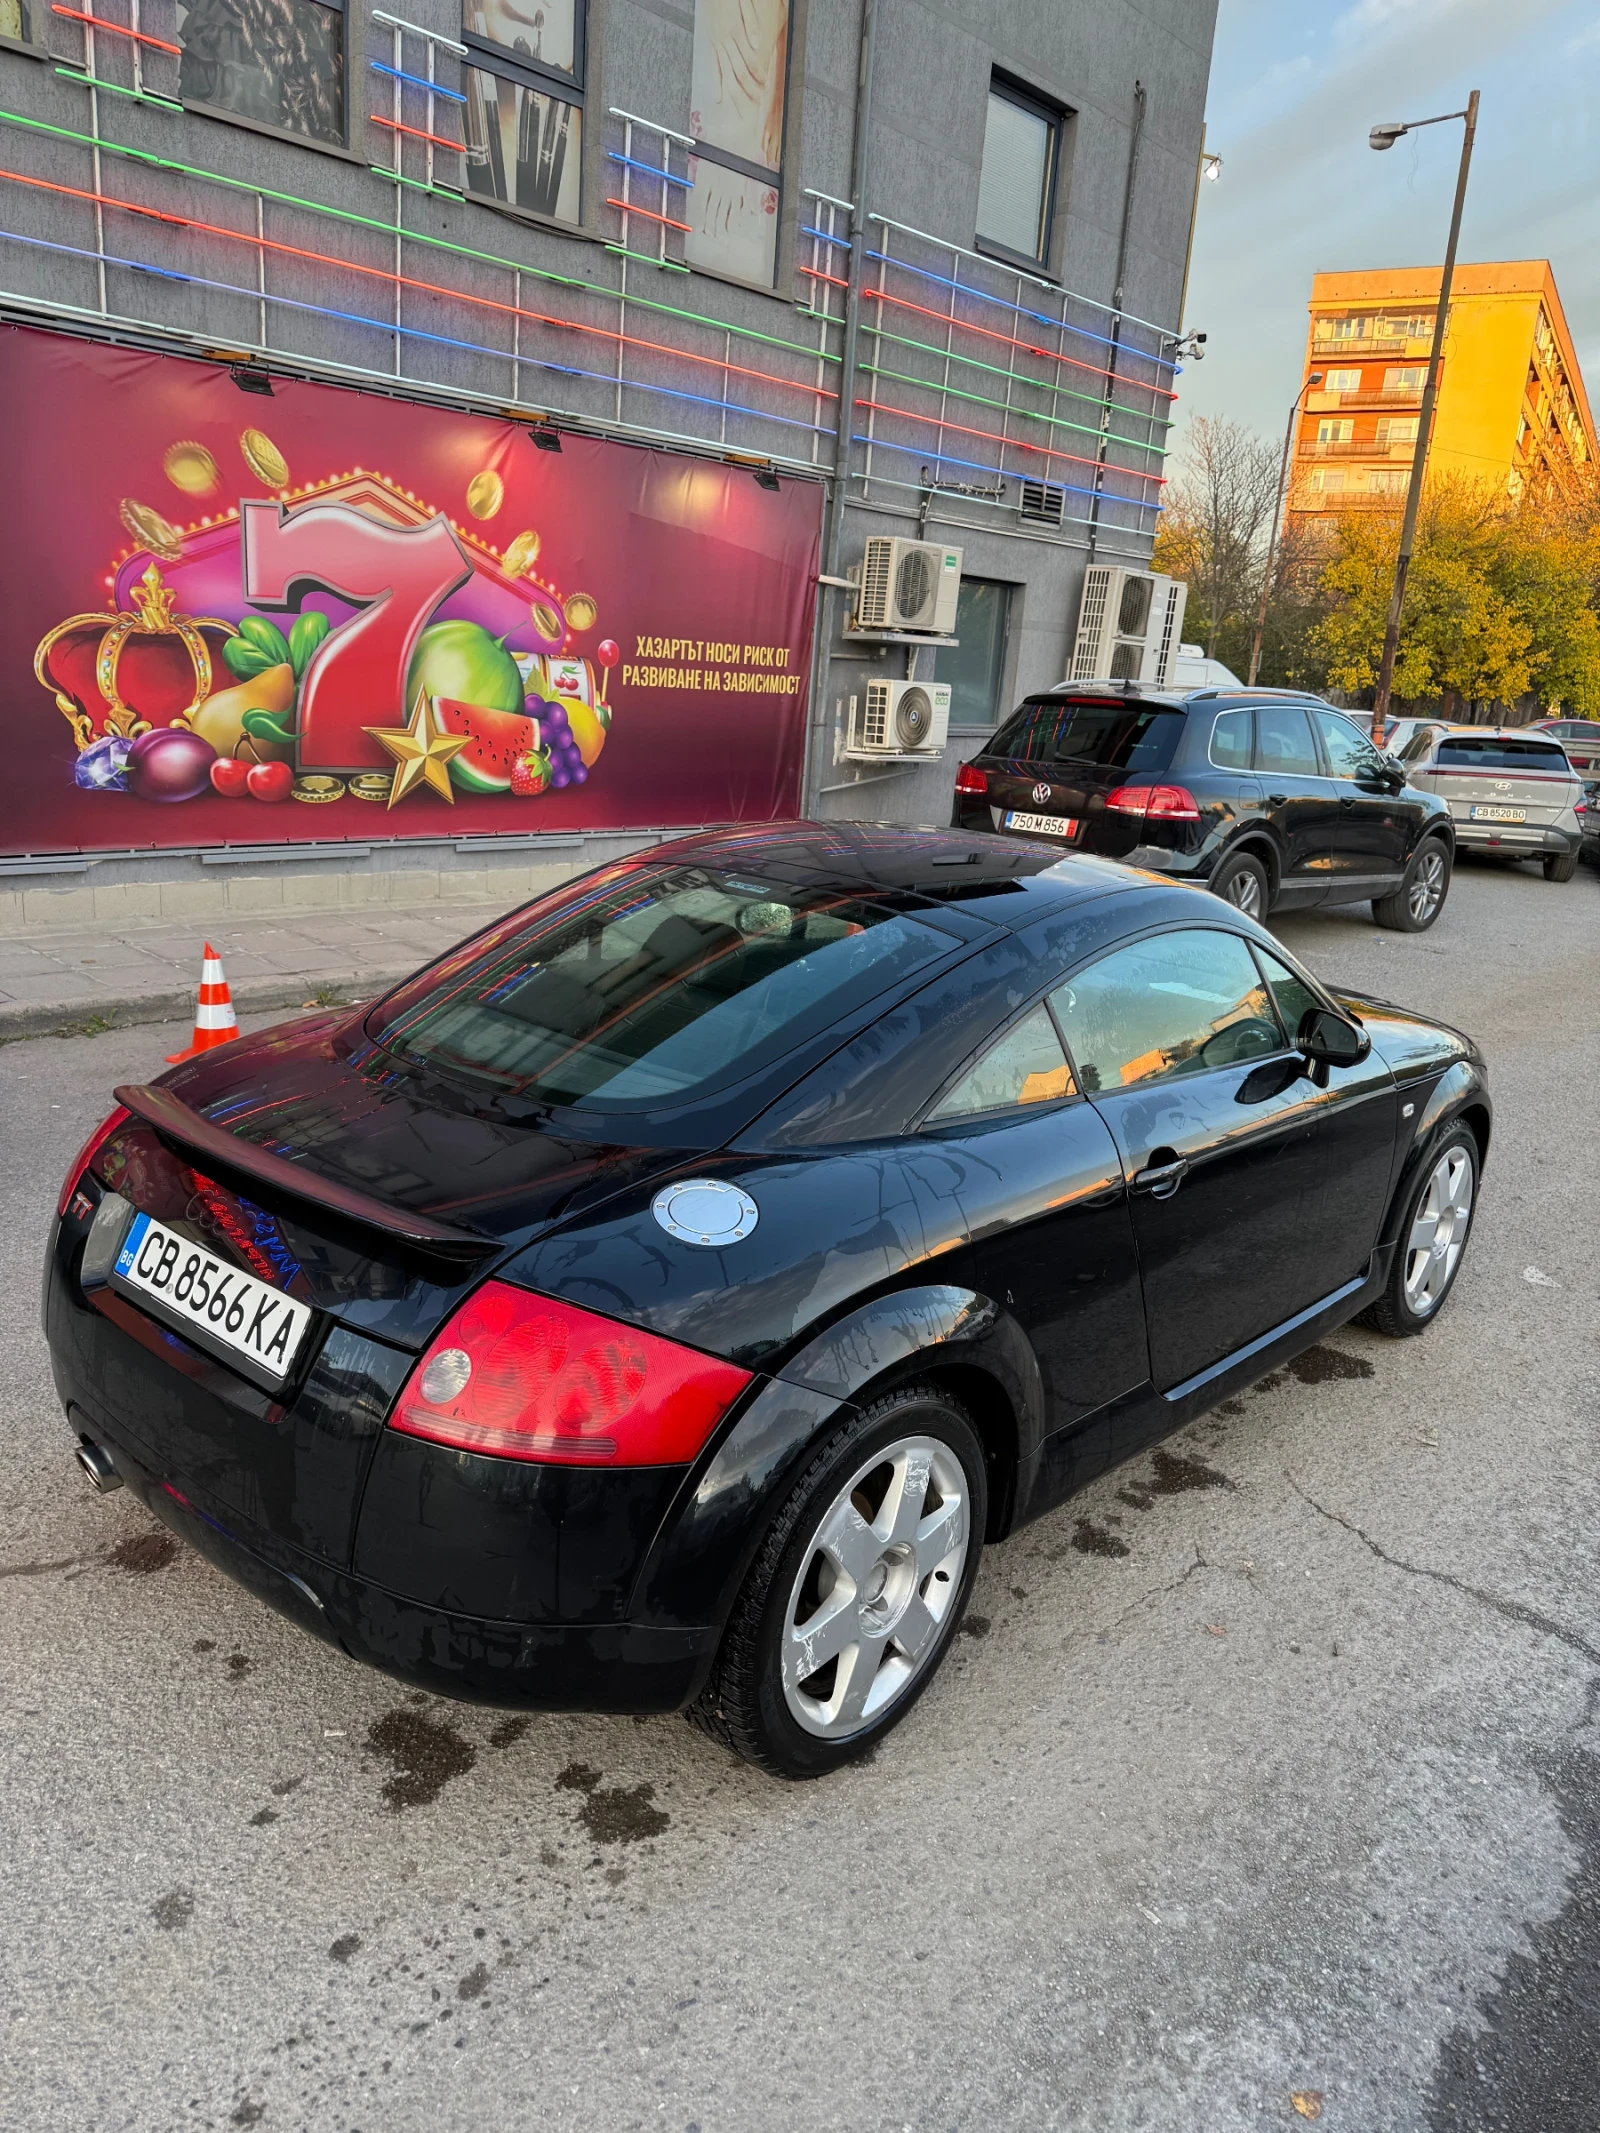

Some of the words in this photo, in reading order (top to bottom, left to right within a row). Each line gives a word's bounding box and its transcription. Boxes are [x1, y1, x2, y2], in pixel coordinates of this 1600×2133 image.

[240, 498, 475, 774] 7
[635, 635, 704, 661] ХАЗАРТЪТ
[705, 642, 740, 664] НОСИ
[743, 645, 774, 667] РИСК
[776, 648, 790, 667] ОТ
[622, 664, 702, 690] РАЗВИВАНЕ
[704, 670, 721, 691] НА
[723, 672, 800, 694] ЗАВИСИМОСТ
[1013, 814, 1033, 829] 750
[1034, 817, 1043, 831] M
[1044, 819, 1064, 834] 856
[1490, 808, 1511, 818] 8520
[120, 1250, 133, 1267] BG
